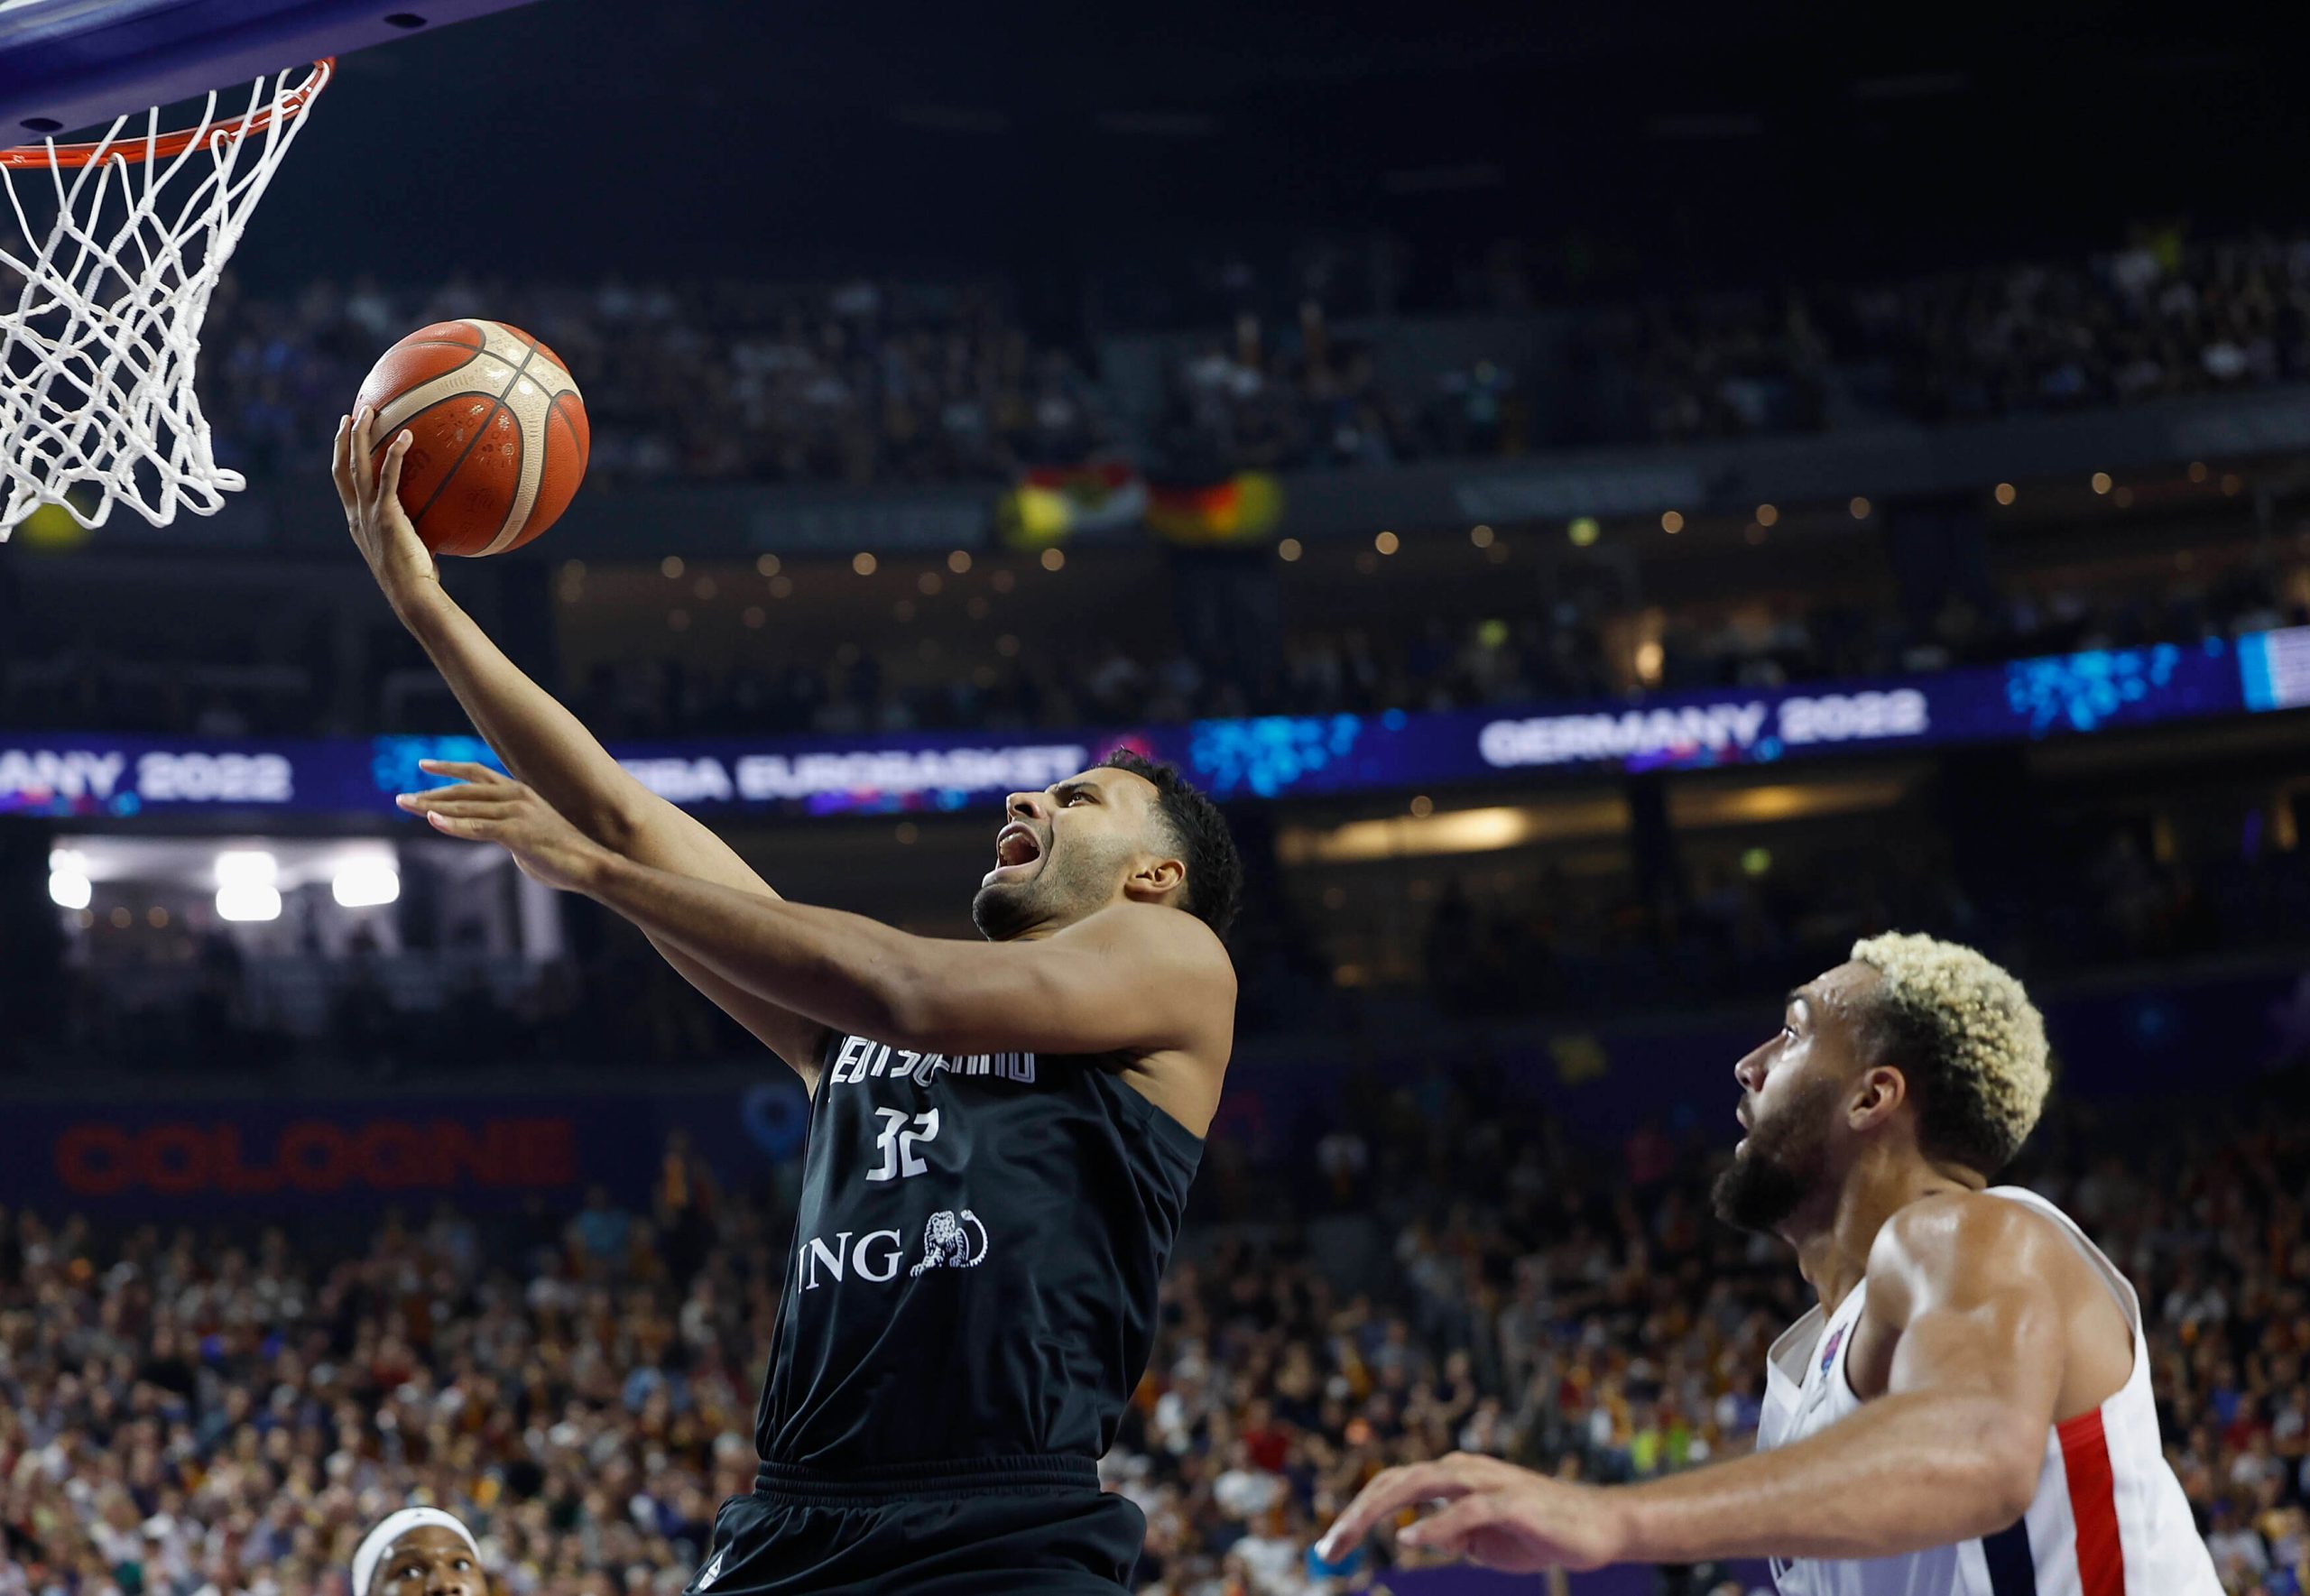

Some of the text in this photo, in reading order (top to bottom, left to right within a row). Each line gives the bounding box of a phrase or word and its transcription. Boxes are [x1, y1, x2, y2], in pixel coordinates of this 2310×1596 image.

[1479, 687, 1928, 768] GERMANY 2022
[137, 752, 295, 802] 2022
[735, 743, 1088, 800] EUROBASKET
[53, 1118, 578, 1197] COLOGNE
[865, 1106, 939, 1181] 32
[798, 1228, 903, 1295] ING
